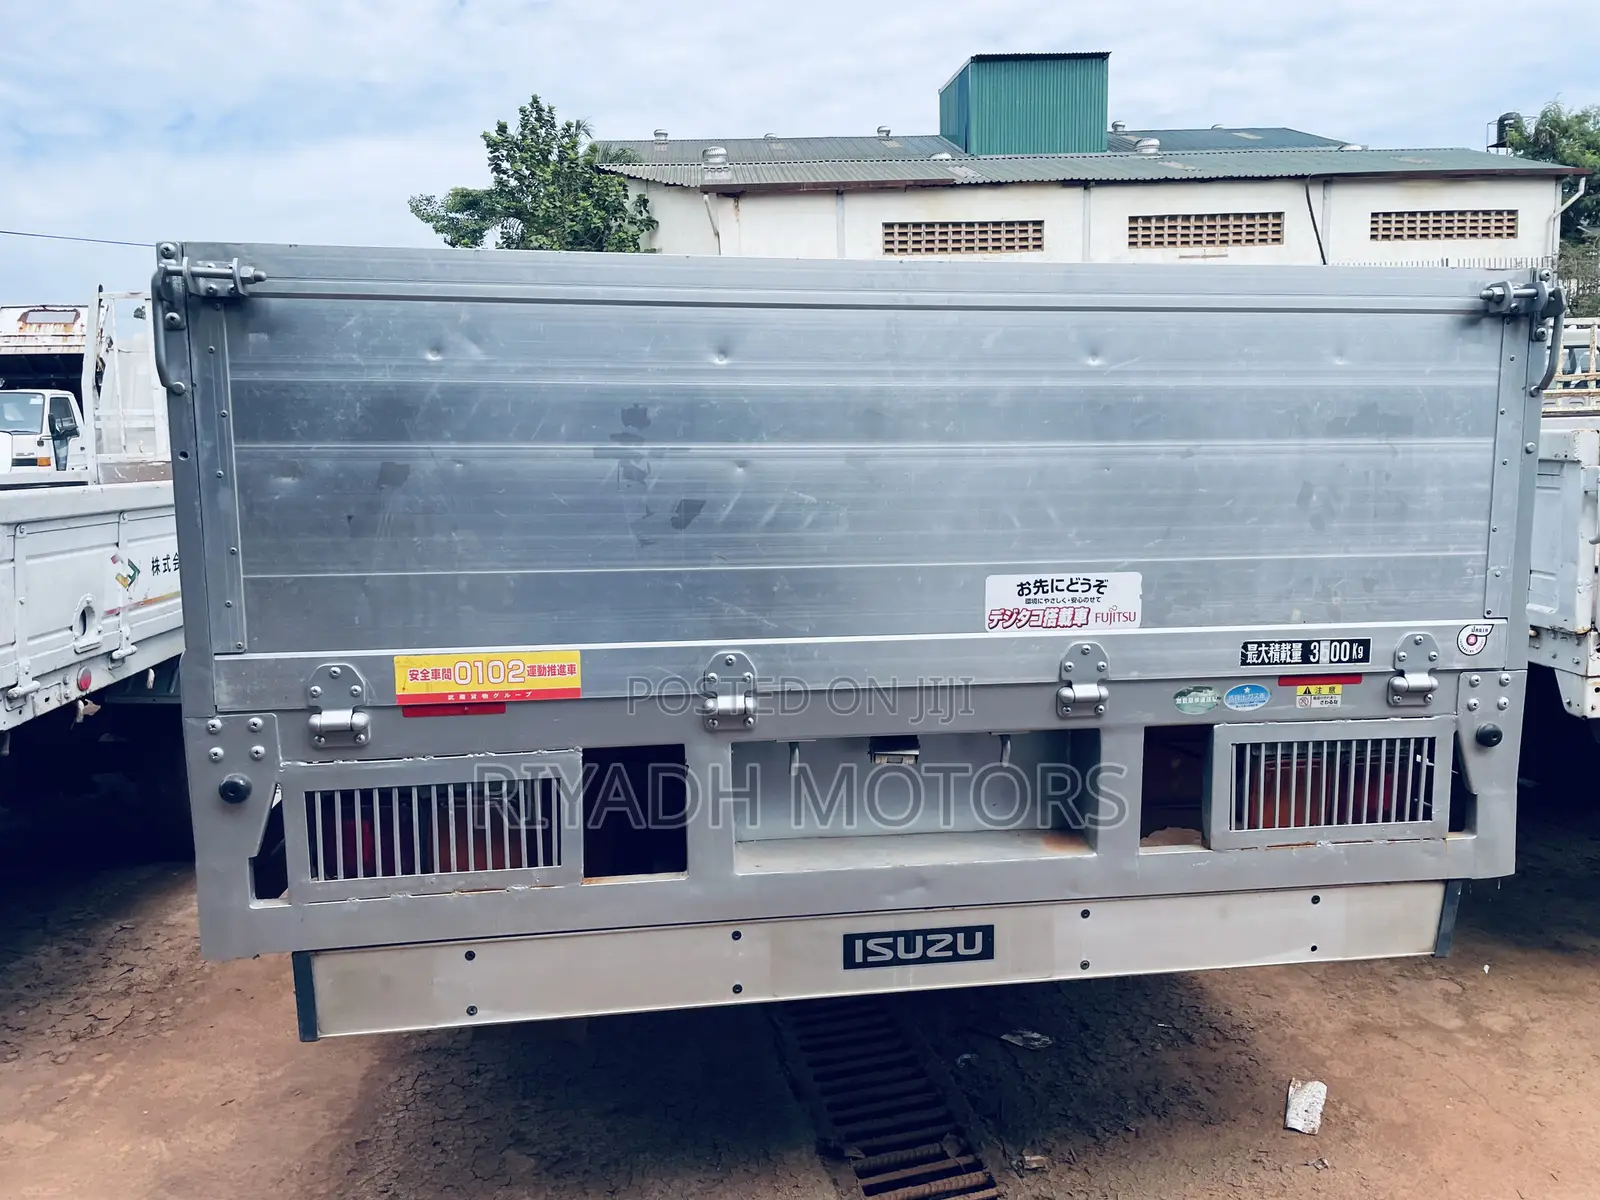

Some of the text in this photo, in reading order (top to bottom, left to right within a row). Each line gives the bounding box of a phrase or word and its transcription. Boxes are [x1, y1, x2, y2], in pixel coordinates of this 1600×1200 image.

[1016, 577, 1109, 597] お先にどうぞ
[987, 607, 1091, 630] デジタコ搭載車
[1095, 605, 1137, 626] FUJITSU
[1246, 643, 1303, 664] 最大積載量
[408, 659, 578, 686] 安全車間0102運動推進車
[853, 932, 984, 963] ISUZU
